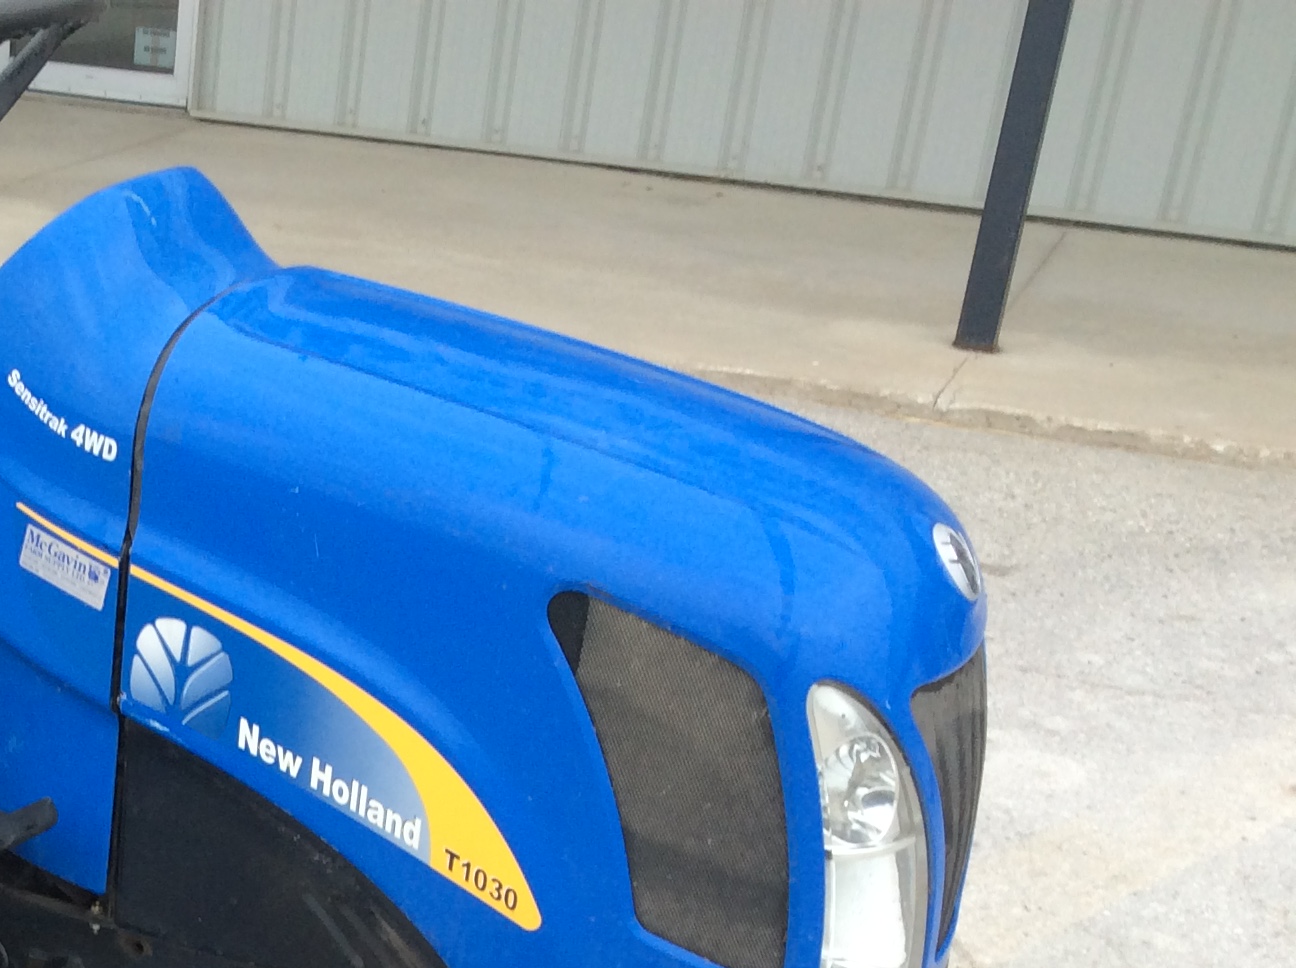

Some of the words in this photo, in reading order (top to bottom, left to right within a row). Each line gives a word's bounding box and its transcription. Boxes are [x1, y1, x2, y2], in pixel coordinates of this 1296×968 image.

[7, 368, 69, 438] Sensitrak
[70, 423, 118, 462] 4WD
[27, 528, 88, 575] McGavin
[237, 715, 303, 780] New
[309, 755, 421, 850] Holland
[443, 848, 518, 912] T1030
